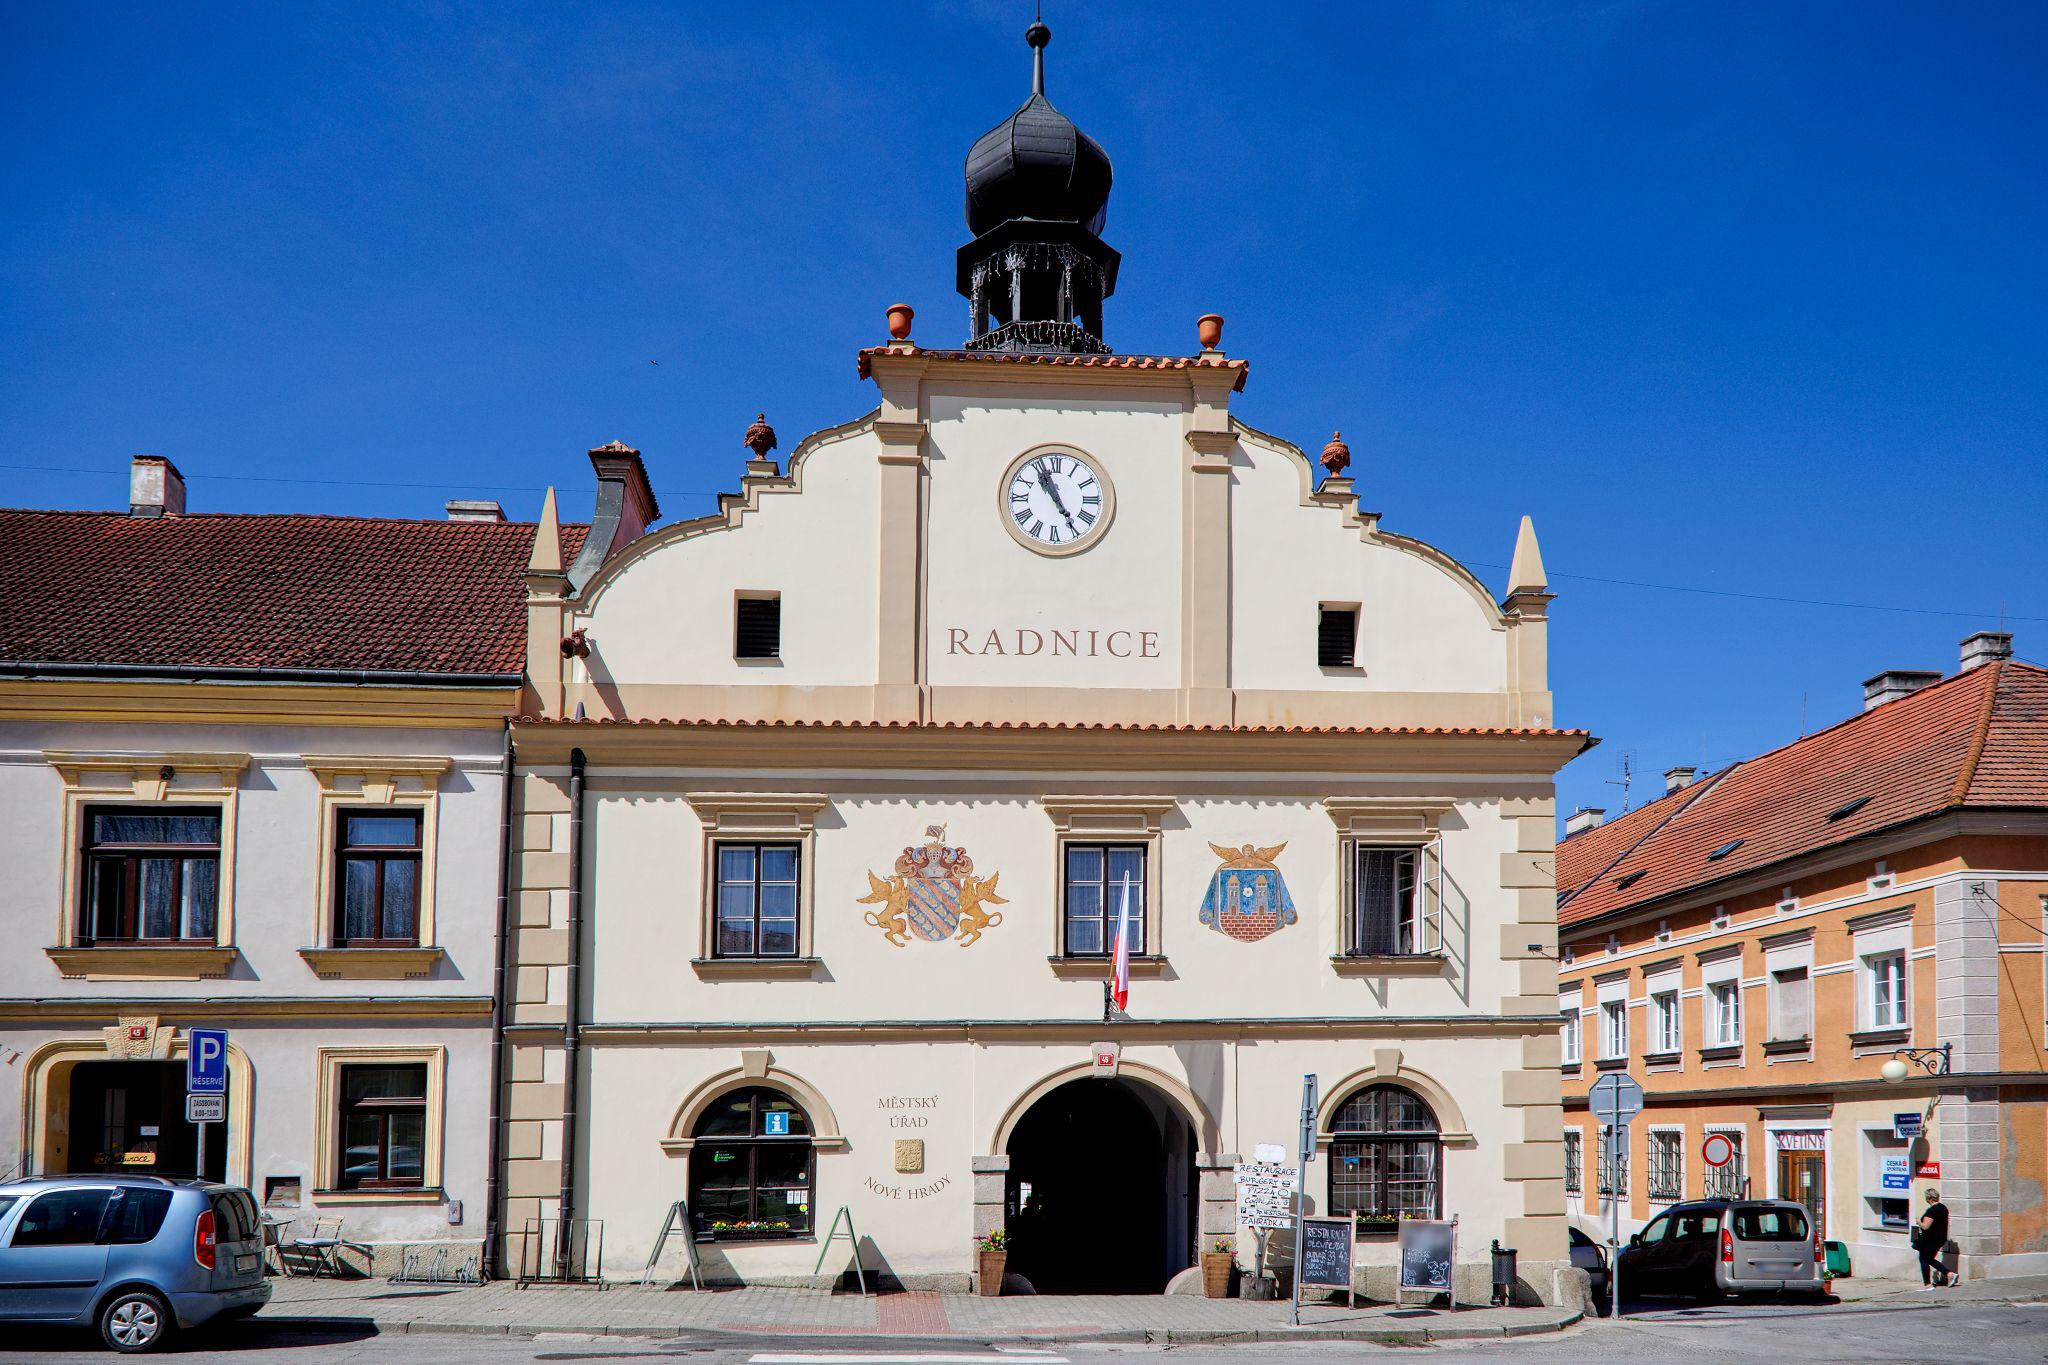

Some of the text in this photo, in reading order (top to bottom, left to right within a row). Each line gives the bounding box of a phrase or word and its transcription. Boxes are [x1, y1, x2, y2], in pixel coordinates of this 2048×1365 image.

[947, 628, 1161, 658] RADNICE
[200, 1037, 221, 1073] P
[192, 1076, 223, 1086] RÉSERVÉ
[878, 1094, 939, 1109] MĚSTSKÝ
[889, 1115, 928, 1128] ÚŘAD
[1239, 1164, 1297, 1176] RESTAURACE
[864, 1172, 952, 1200] NOVÉ HRADY
[1237, 1176, 1279, 1186] BURGERY
[1247, 1186, 1275, 1196] PIZZA
[1241, 1216, 1284, 1228] ZAHRÁDKA
